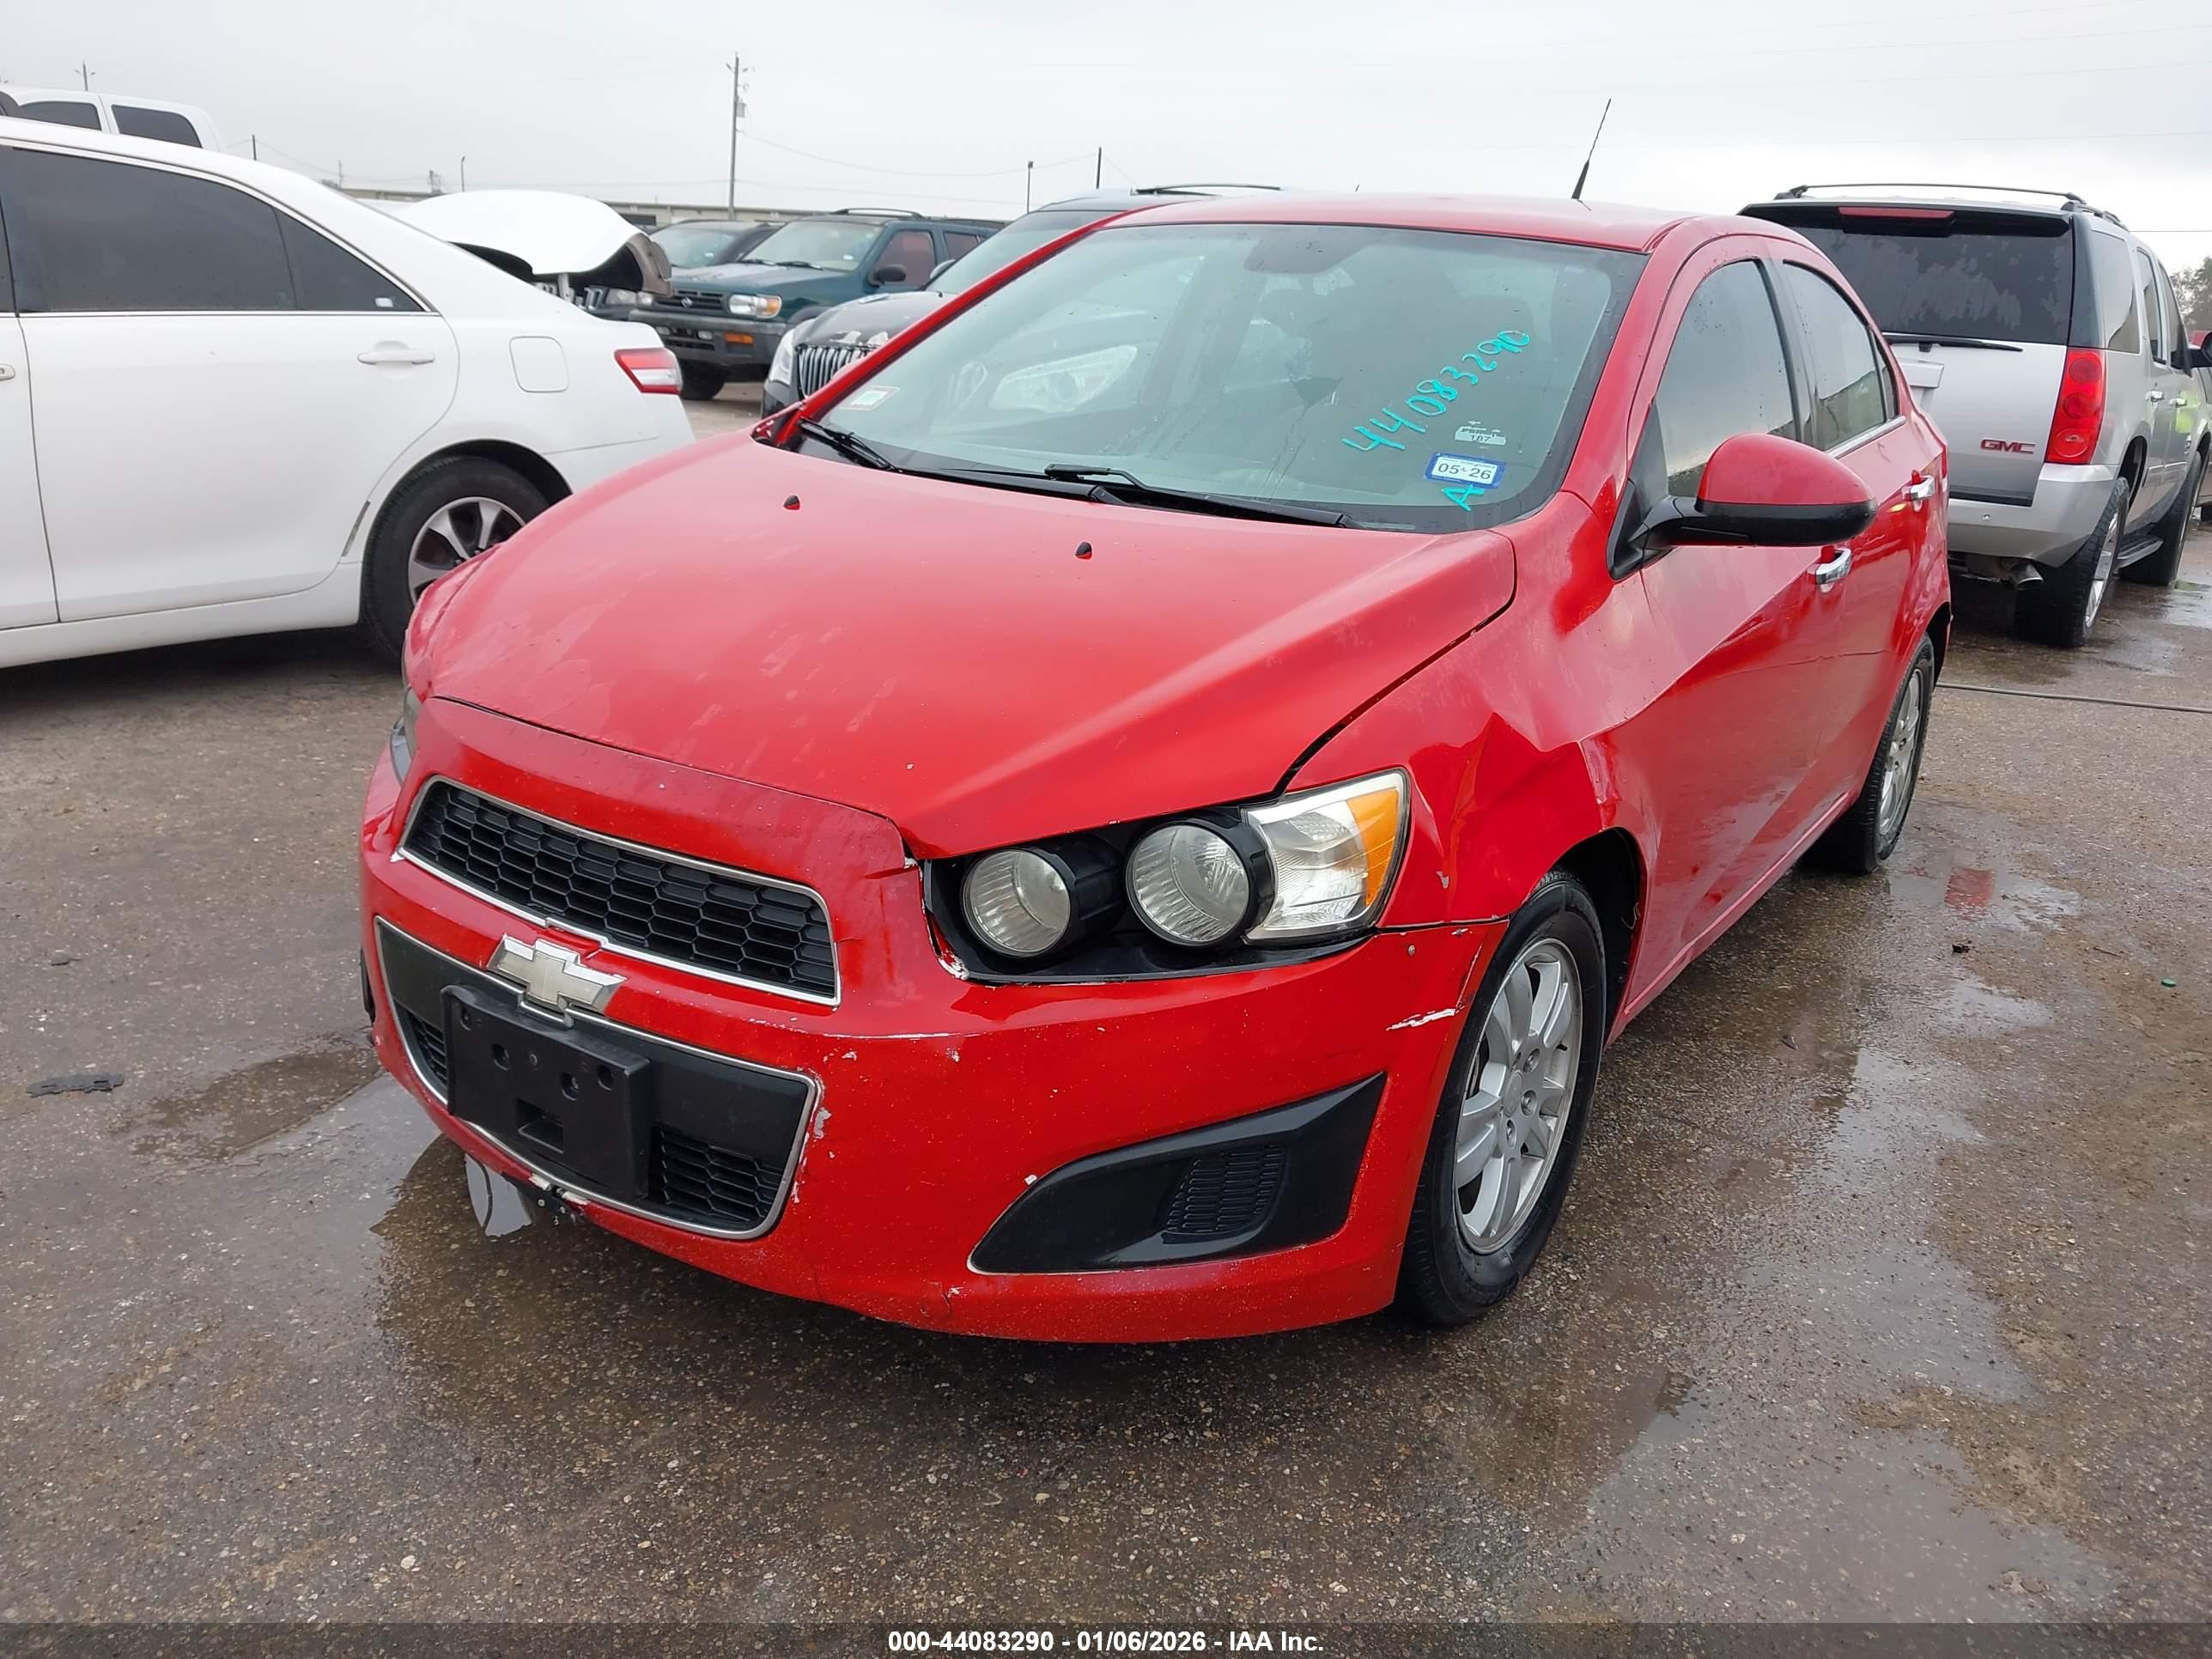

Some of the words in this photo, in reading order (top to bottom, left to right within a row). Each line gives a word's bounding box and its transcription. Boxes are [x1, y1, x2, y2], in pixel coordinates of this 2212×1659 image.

[1341, 330, 1529, 451] 44083290
[1980, 439, 2036, 454] GMC
[1437, 463, 1461, 475] 05
[1468, 467, 1492, 480] 26
